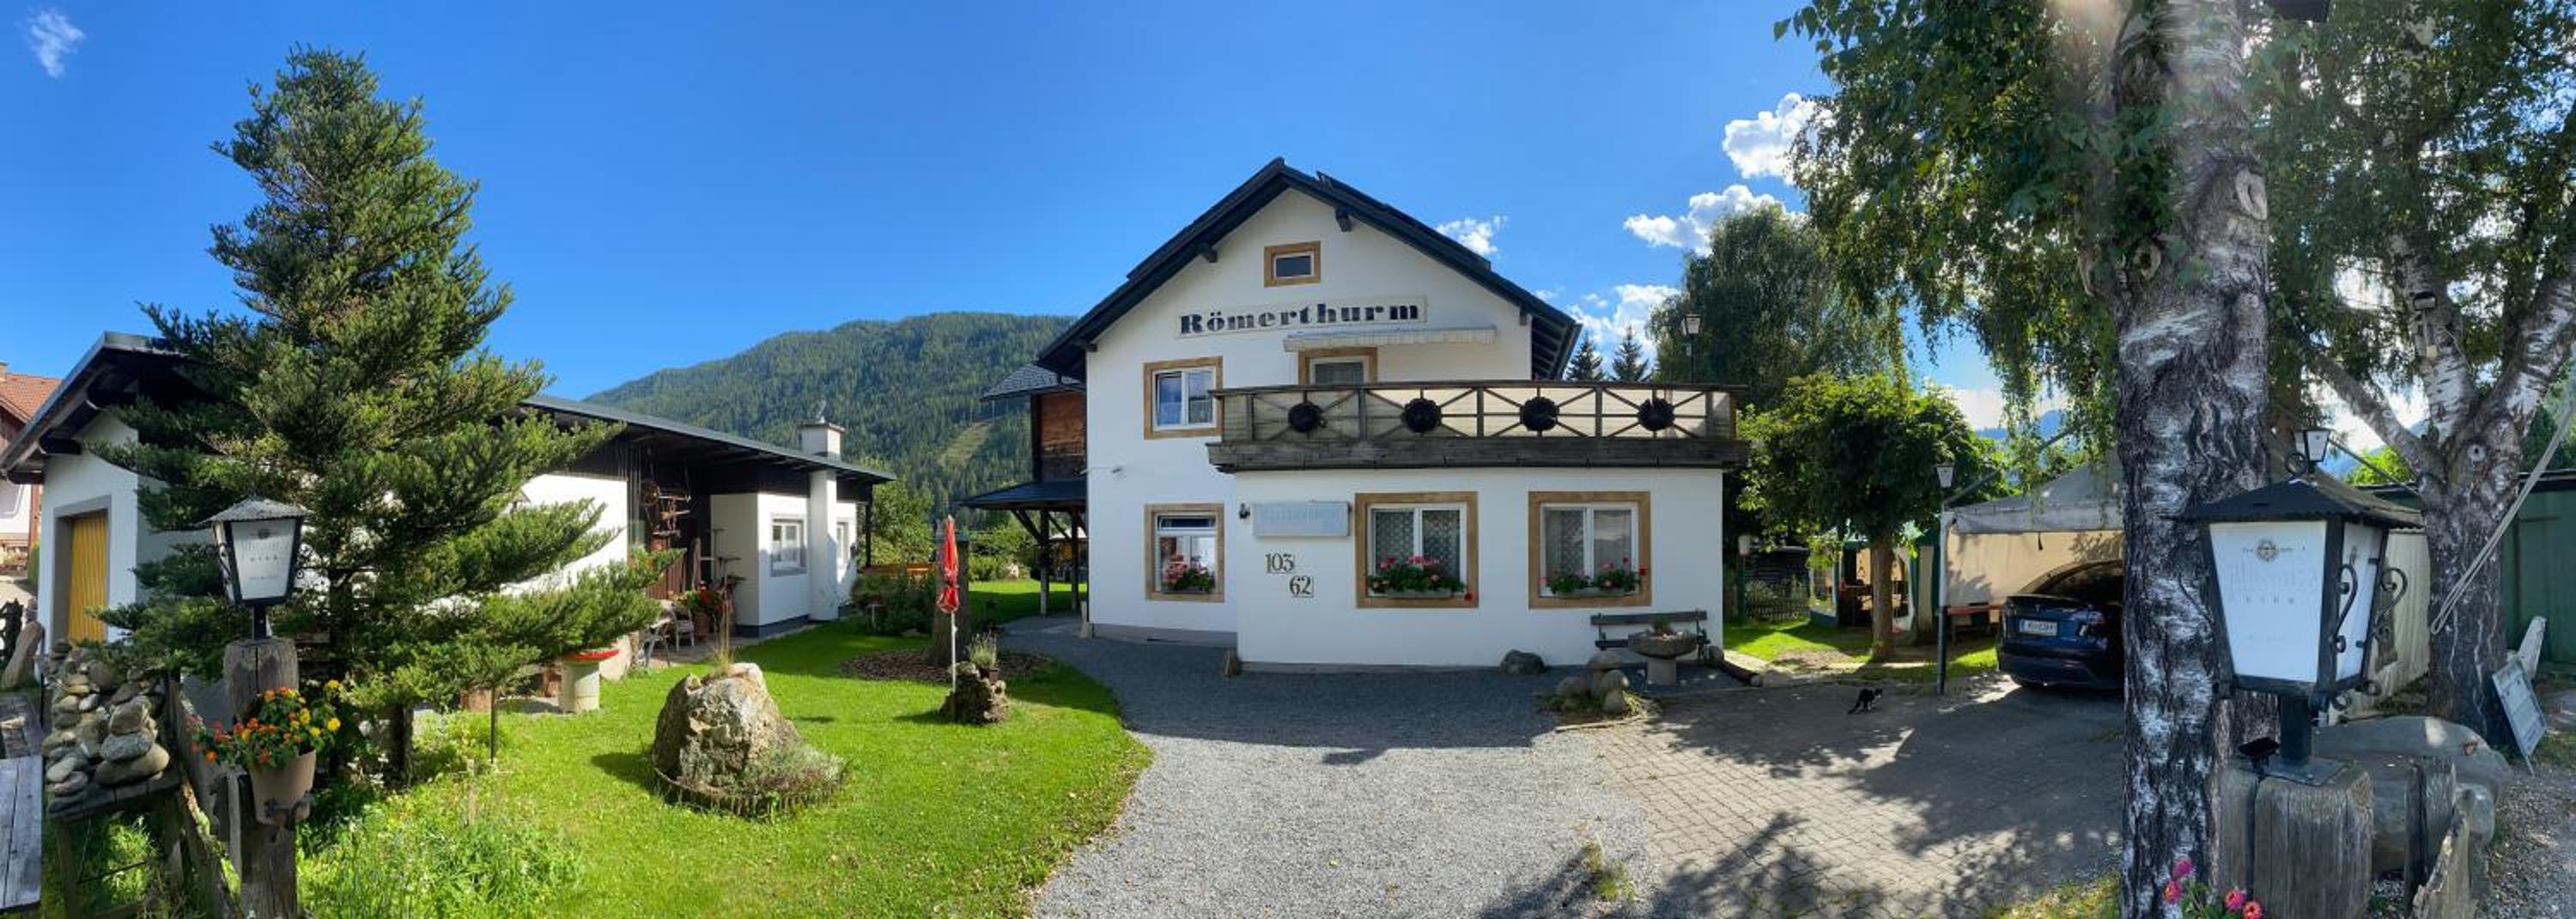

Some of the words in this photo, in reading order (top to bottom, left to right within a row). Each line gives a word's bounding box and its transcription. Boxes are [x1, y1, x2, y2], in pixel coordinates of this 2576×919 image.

[1181, 303, 1419, 334] Römerthurm
[1265, 553, 1294, 573] 103
[1290, 575, 1311, 596] 62
